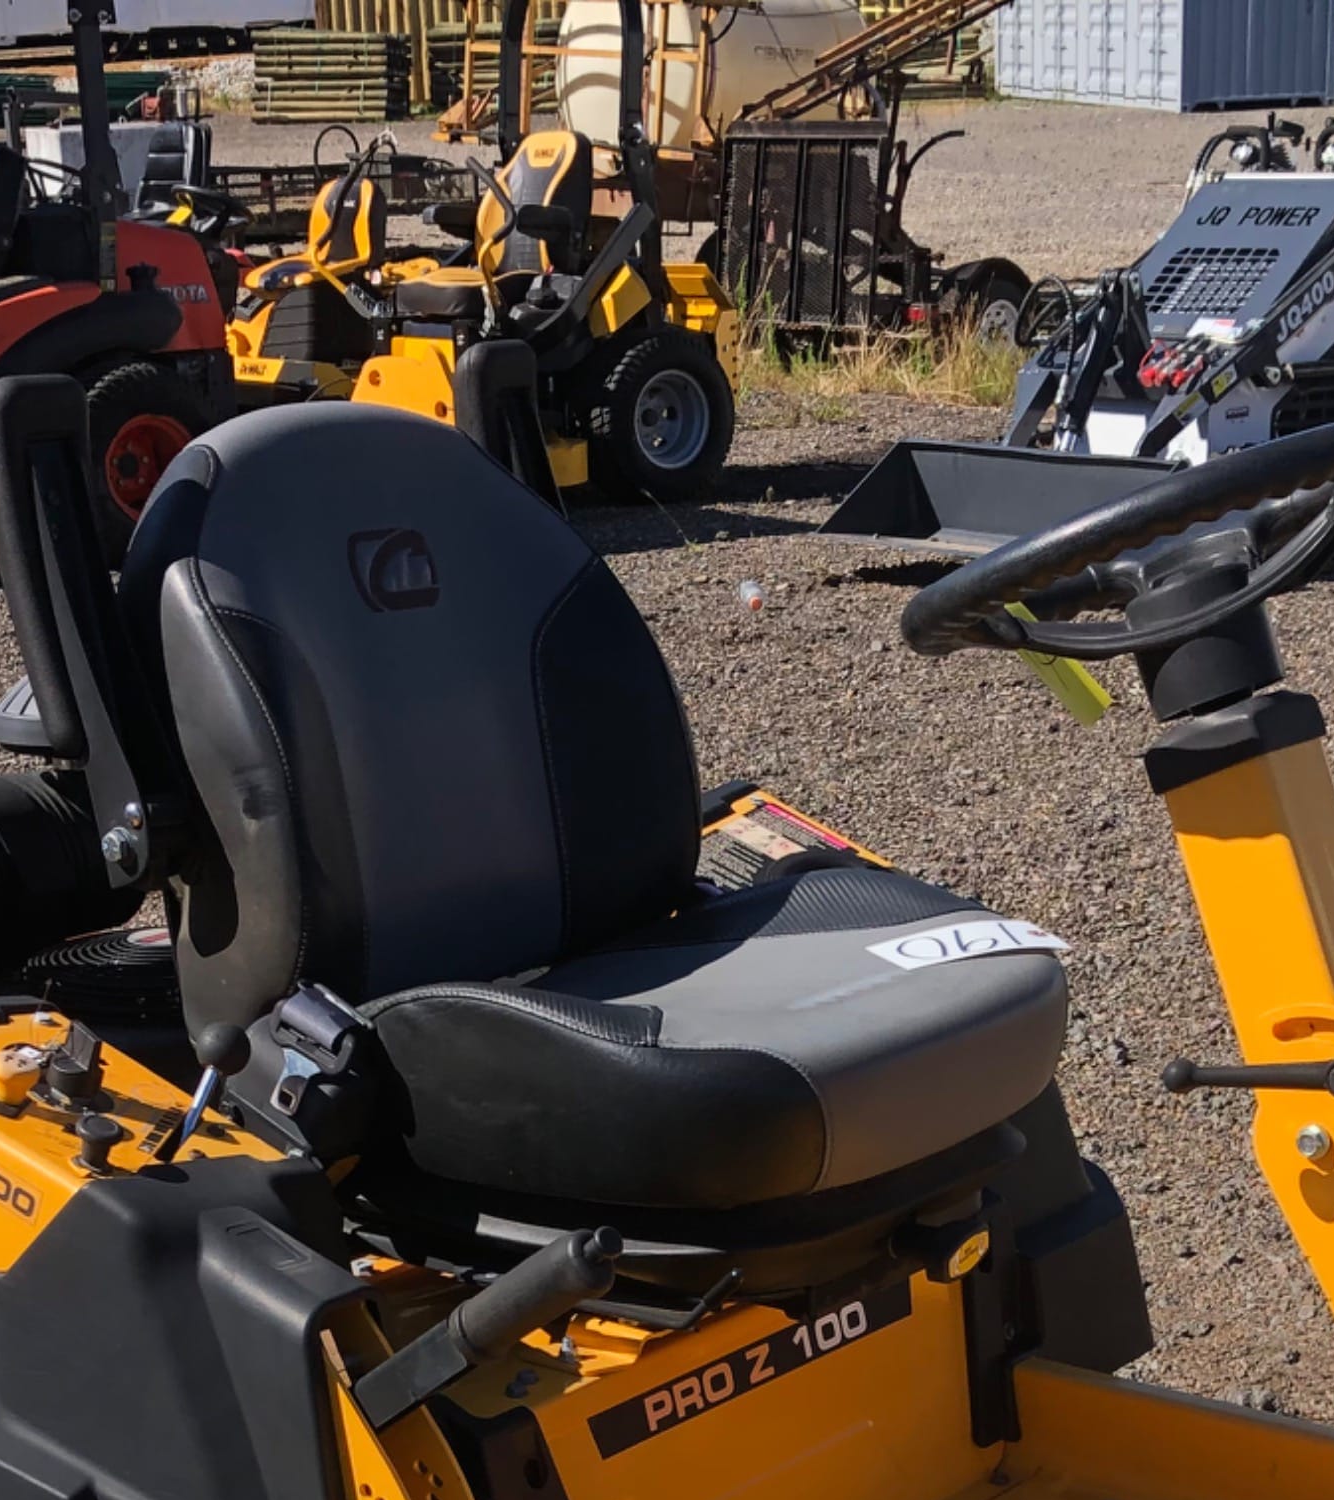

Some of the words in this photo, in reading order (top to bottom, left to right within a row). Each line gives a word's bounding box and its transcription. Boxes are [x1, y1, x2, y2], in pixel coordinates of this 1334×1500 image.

[1196, 206, 1232, 227] JQ
[1237, 205, 1321, 228] POWER
[643, 1361, 736, 1432] PRO
[744, 1342, 776, 1385] Z
[792, 1300, 869, 1360] 100
